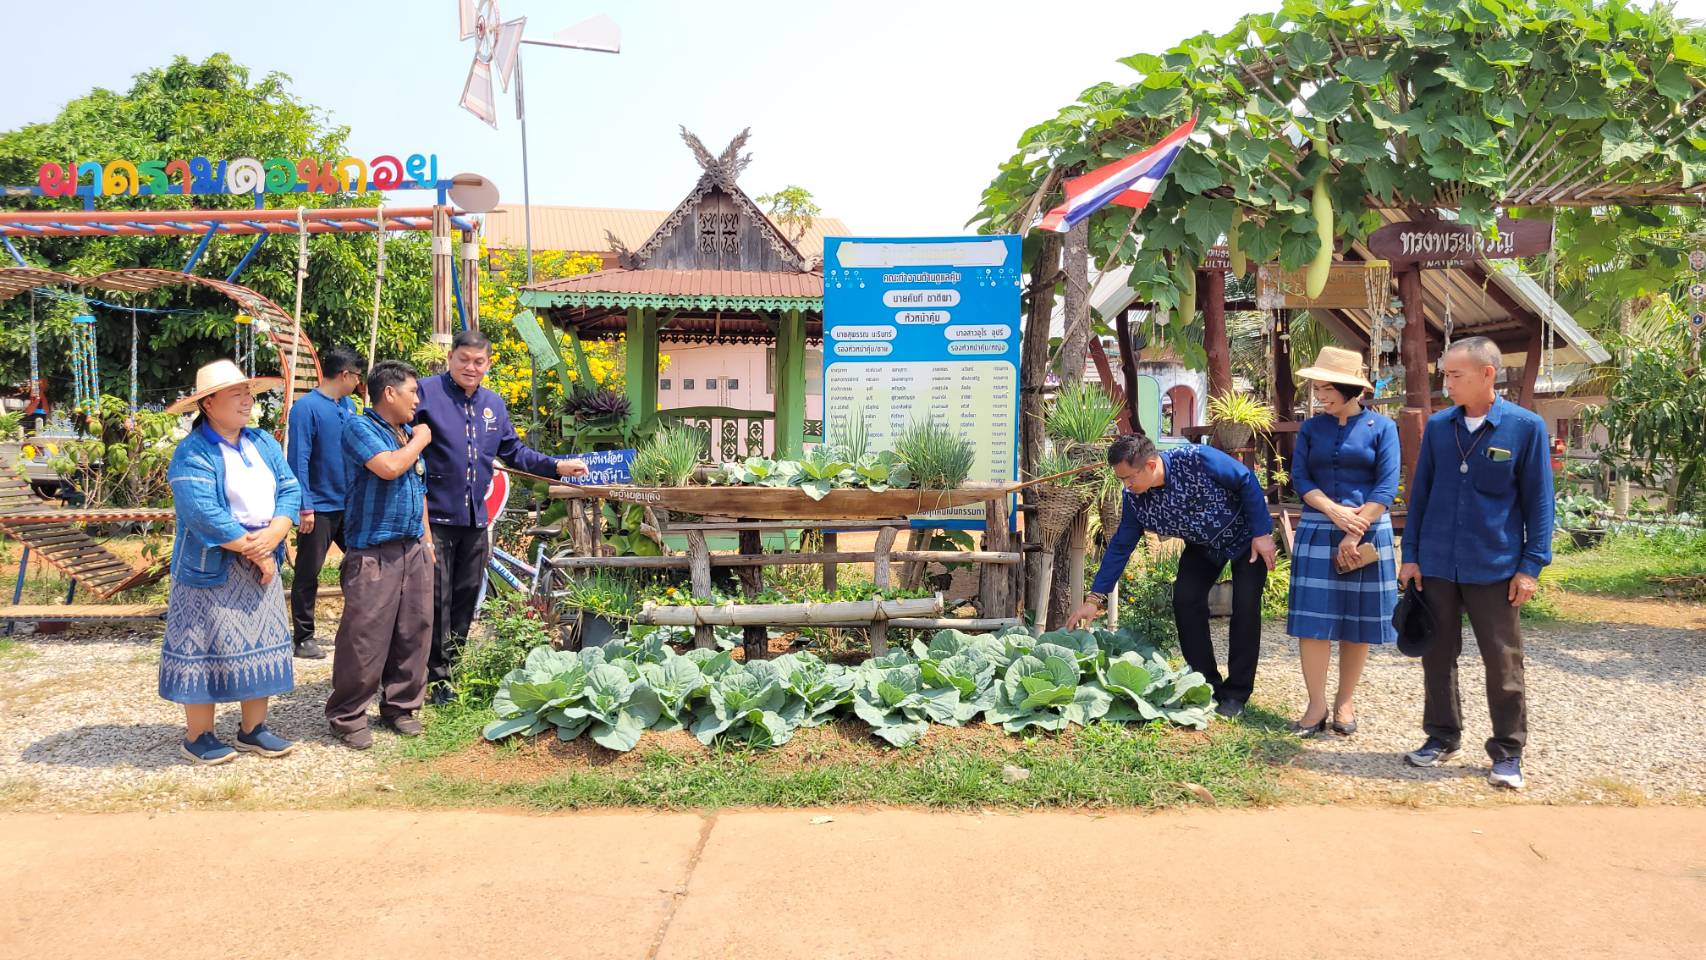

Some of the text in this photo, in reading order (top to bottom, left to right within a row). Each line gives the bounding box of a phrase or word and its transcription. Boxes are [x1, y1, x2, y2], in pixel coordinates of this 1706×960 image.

[904, 312, 940, 325] หัวหน้าคุ้ม
